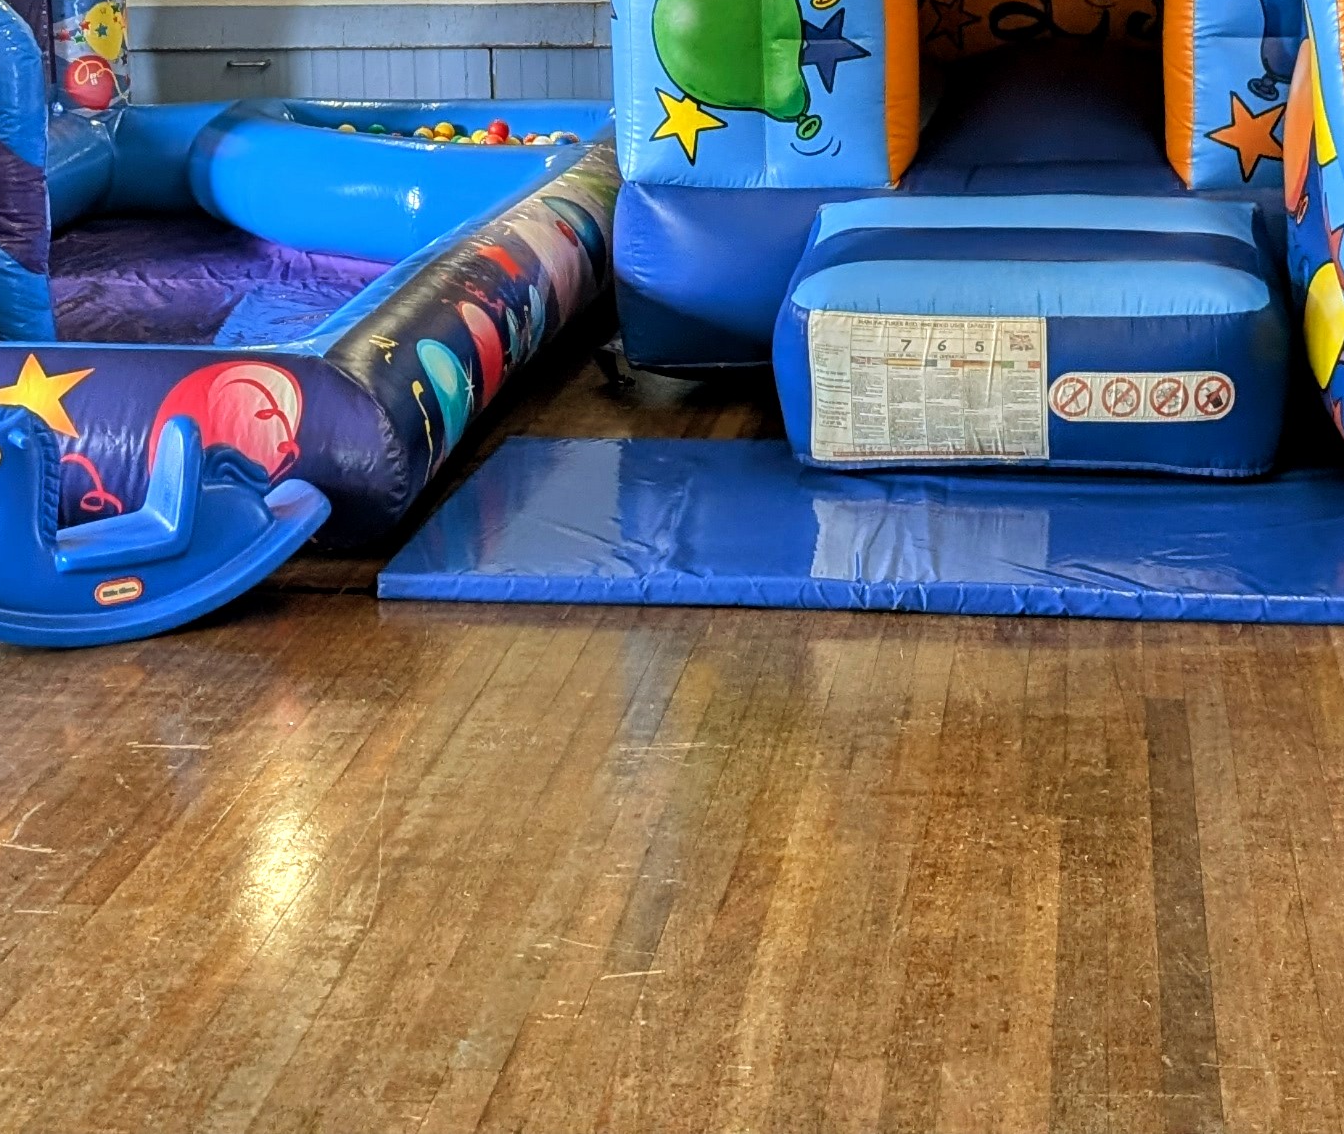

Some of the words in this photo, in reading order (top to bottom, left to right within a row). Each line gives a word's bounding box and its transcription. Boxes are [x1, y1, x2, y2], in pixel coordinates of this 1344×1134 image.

[901, 339, 912, 352] 7
[937, 340, 947, 352] 6
[975, 341, 985, 352] 5
